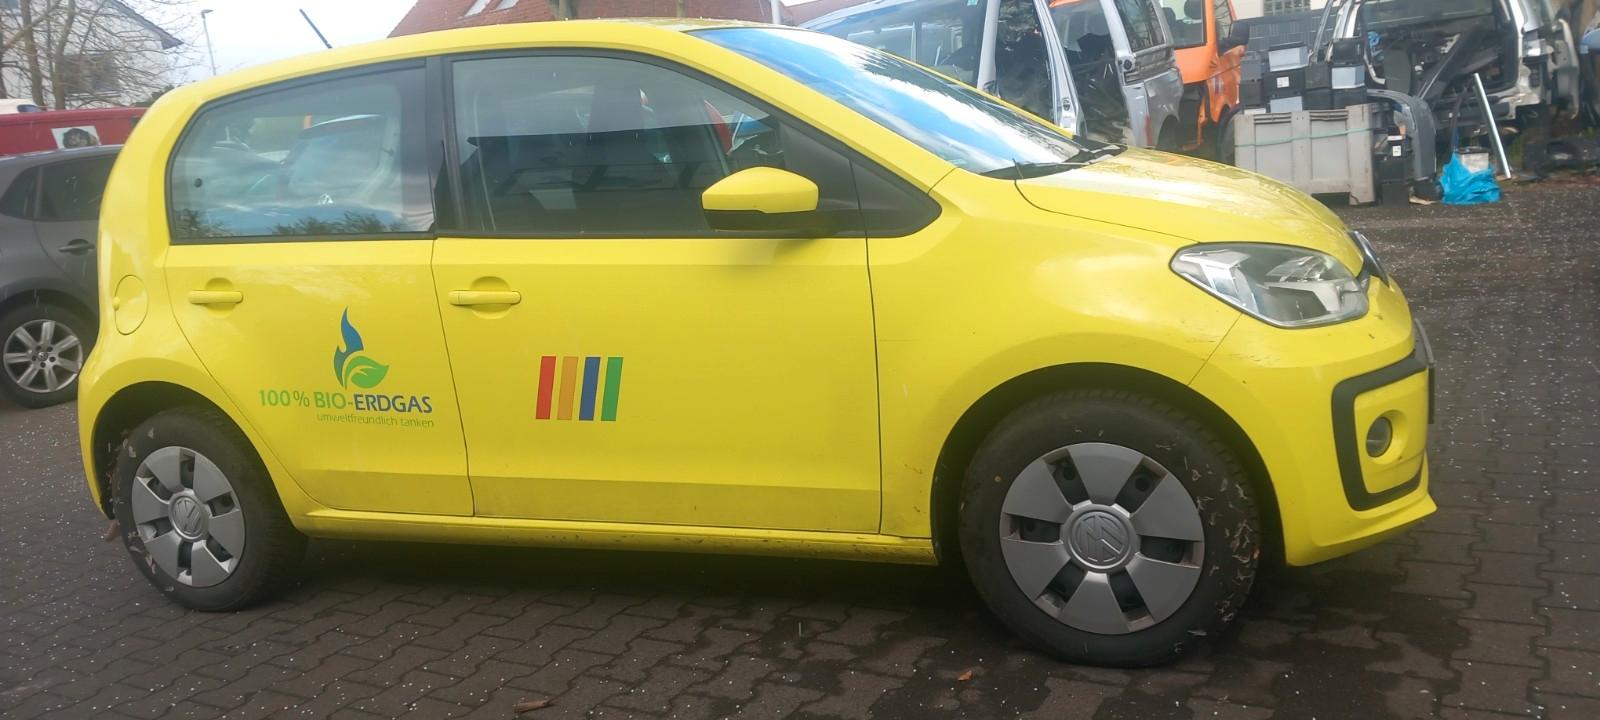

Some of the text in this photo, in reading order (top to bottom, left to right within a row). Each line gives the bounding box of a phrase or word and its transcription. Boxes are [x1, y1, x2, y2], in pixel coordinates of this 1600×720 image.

[258, 389, 291, 407] 100
[313, 391, 433, 413] BIO-ERDGAS
[316, 413, 434, 428] umweltfreundlich tanken
